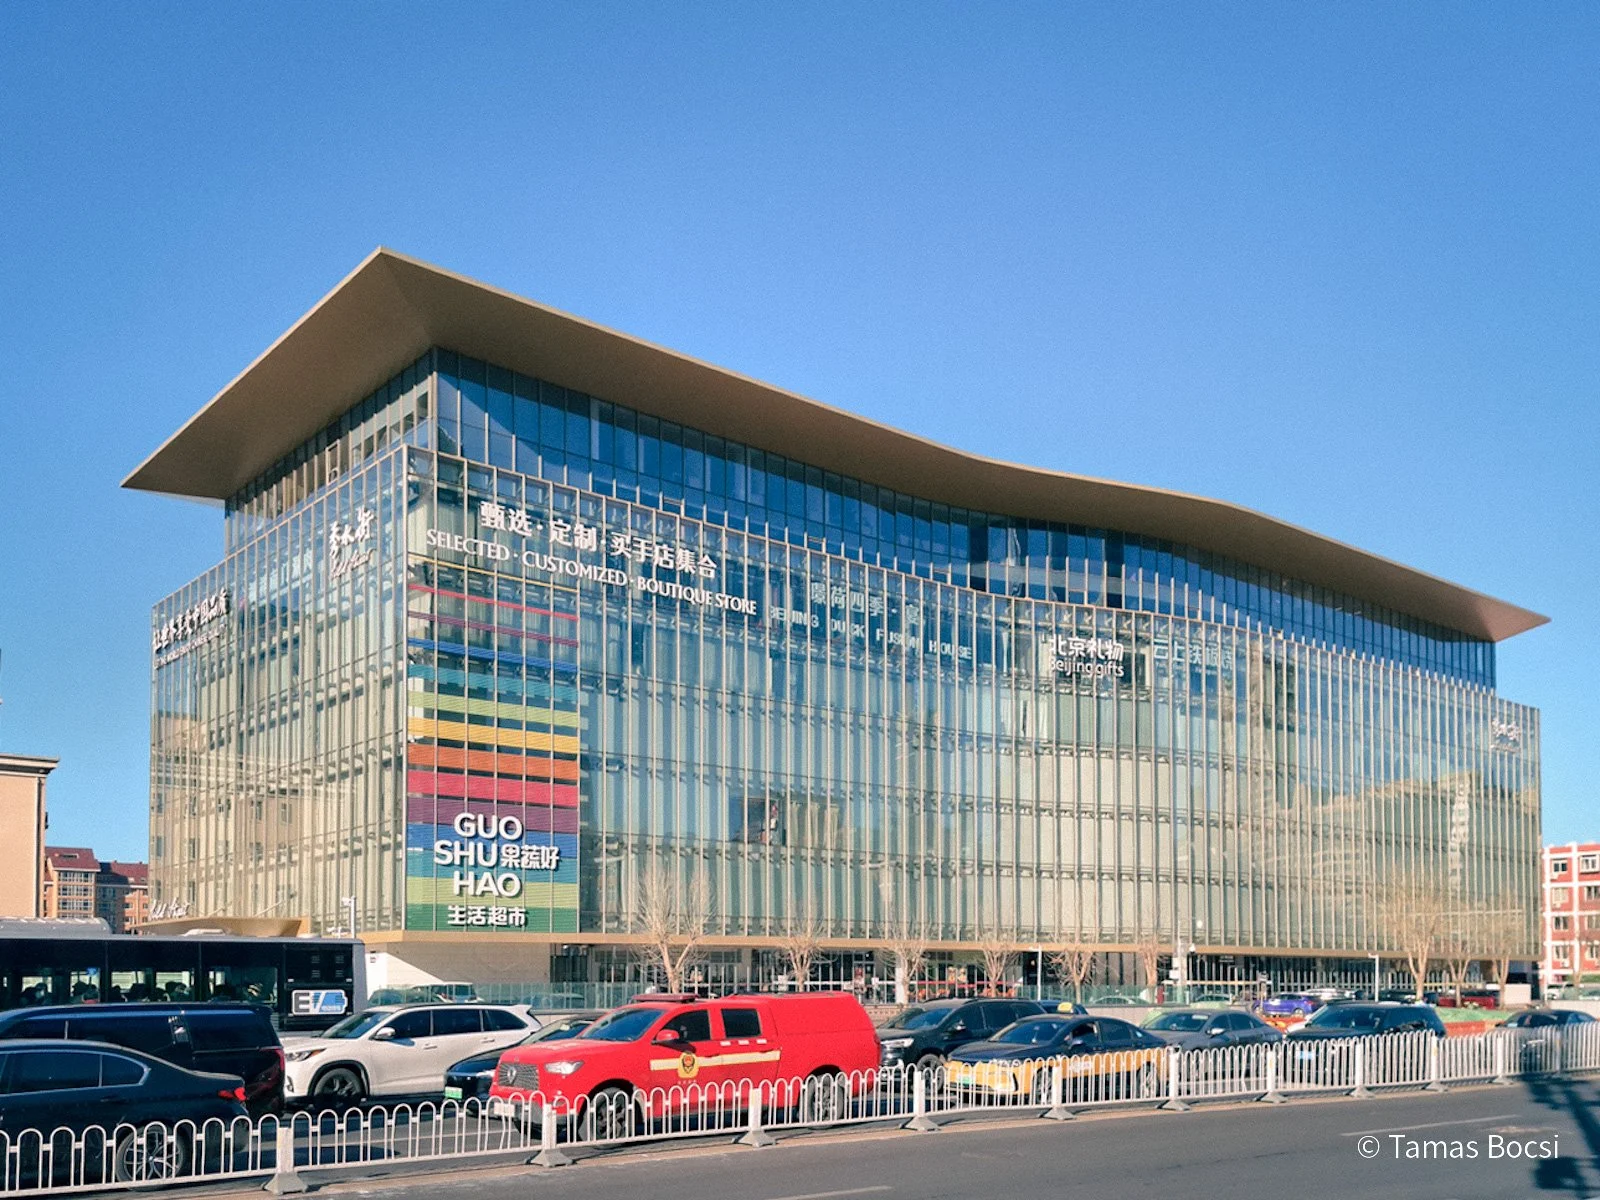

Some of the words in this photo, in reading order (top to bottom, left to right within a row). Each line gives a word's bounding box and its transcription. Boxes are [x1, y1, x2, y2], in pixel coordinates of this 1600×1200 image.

[426, 529, 510, 561] SELECTED
[522, 550, 628, 587] CUSTOMIZED
[638, 575, 713, 606] BOUTIQUE
[715, 592, 757, 616] STORE
[830, 618, 866, 638] DUCK
[876, 628, 920, 649] FUSIN
[929, 640, 973, 660] HOUSE
[1048, 633, 1125, 662] 北京礼物
[453, 812, 523, 841] GUO
[433, 839, 498, 867] SHU
[501, 843, 560, 870] 果蔬好
[453, 870, 522, 898] HAO
[447, 904, 527, 927] 生活超市
